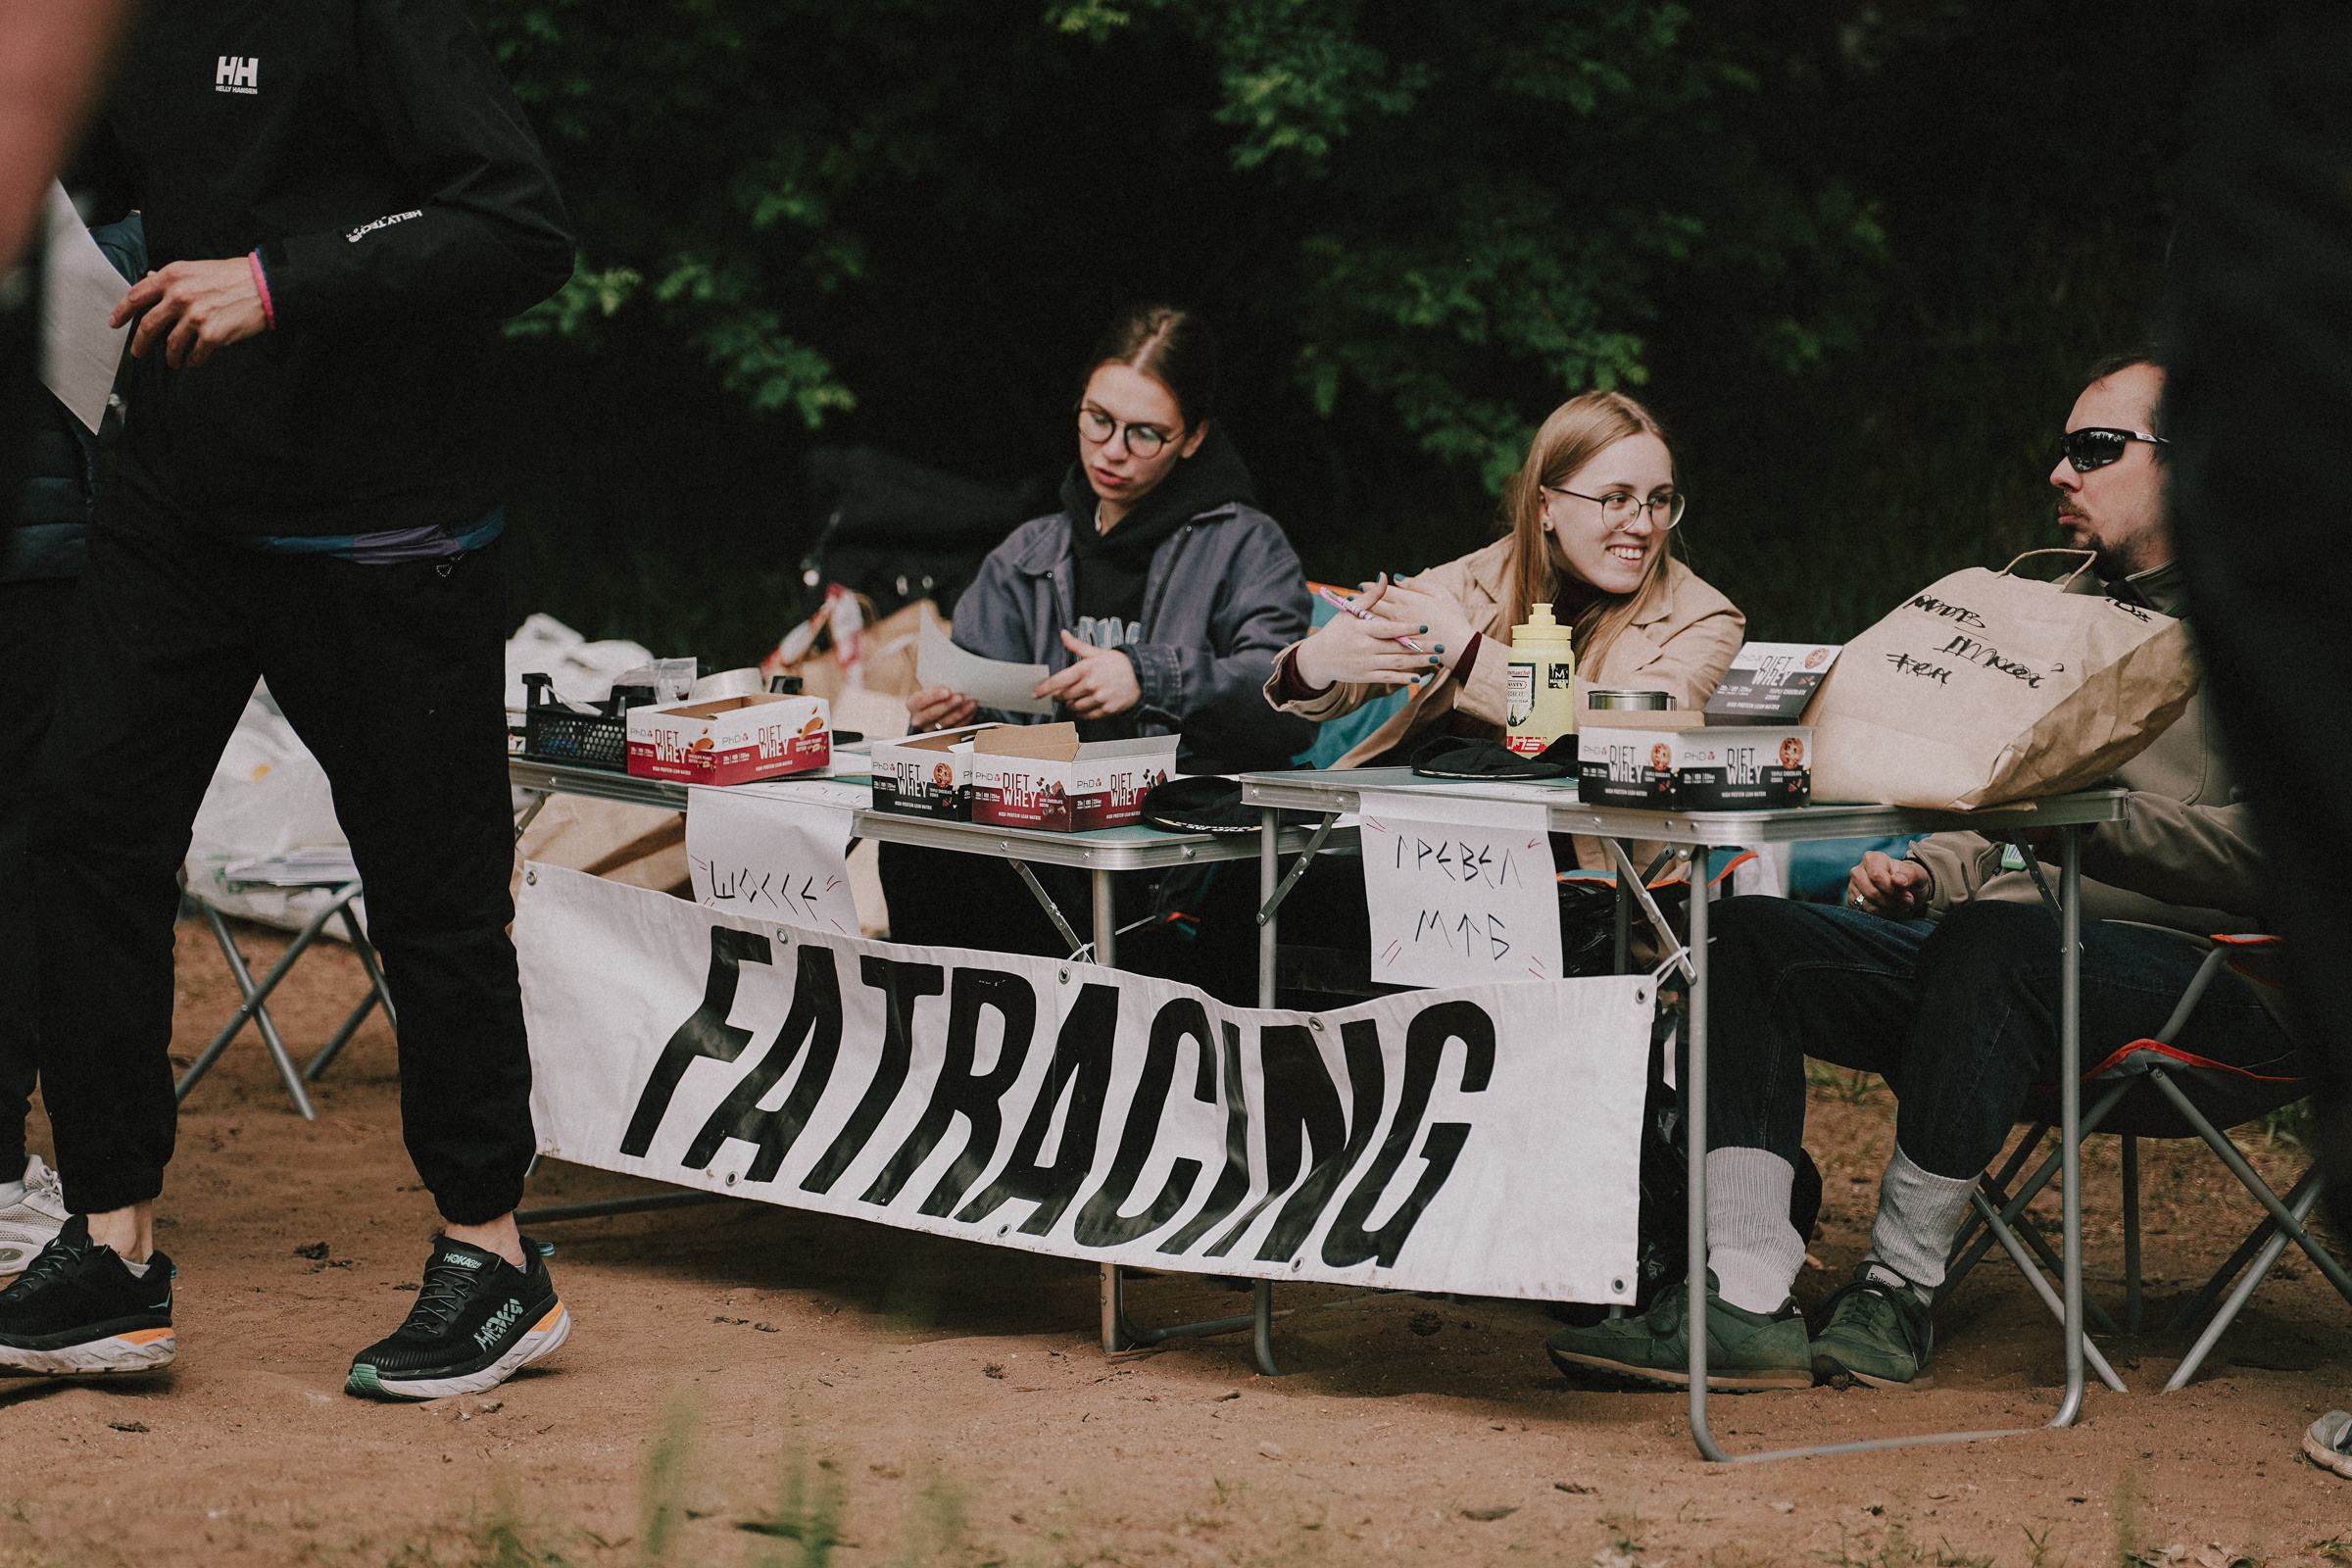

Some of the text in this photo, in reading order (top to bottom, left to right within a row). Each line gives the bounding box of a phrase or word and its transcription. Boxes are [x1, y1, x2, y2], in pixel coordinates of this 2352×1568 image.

[1760, 656, 1794, 671] DIET
[1751, 669, 1793, 686] WHEY
[656, 729, 678, 747] DIET
[759, 724, 782, 744] DIET
[656, 744, 686, 763] WHEY
[759, 738, 790, 760] WHEY
[1610, 745, 1636, 763] DIET
[1727, 748, 1755, 765] DIET
[897, 762, 921, 780] DIET
[1608, 761, 1644, 784] WHEY
[1726, 764, 1764, 785] WHEY
[897, 777, 928, 799] WHEY
[1003, 772, 1031, 791] DIET
[1110, 772, 1132, 791] DIET
[1003, 788, 1038, 808] WHEY
[1110, 787, 1139, 808] WHEY
[710, 859, 818, 922] ШОССЕ
[618, 924, 1497, 1270] FATRACING
[443, 1253, 471, 1267] HOKA
[473, 1298, 524, 1352] HOKA
